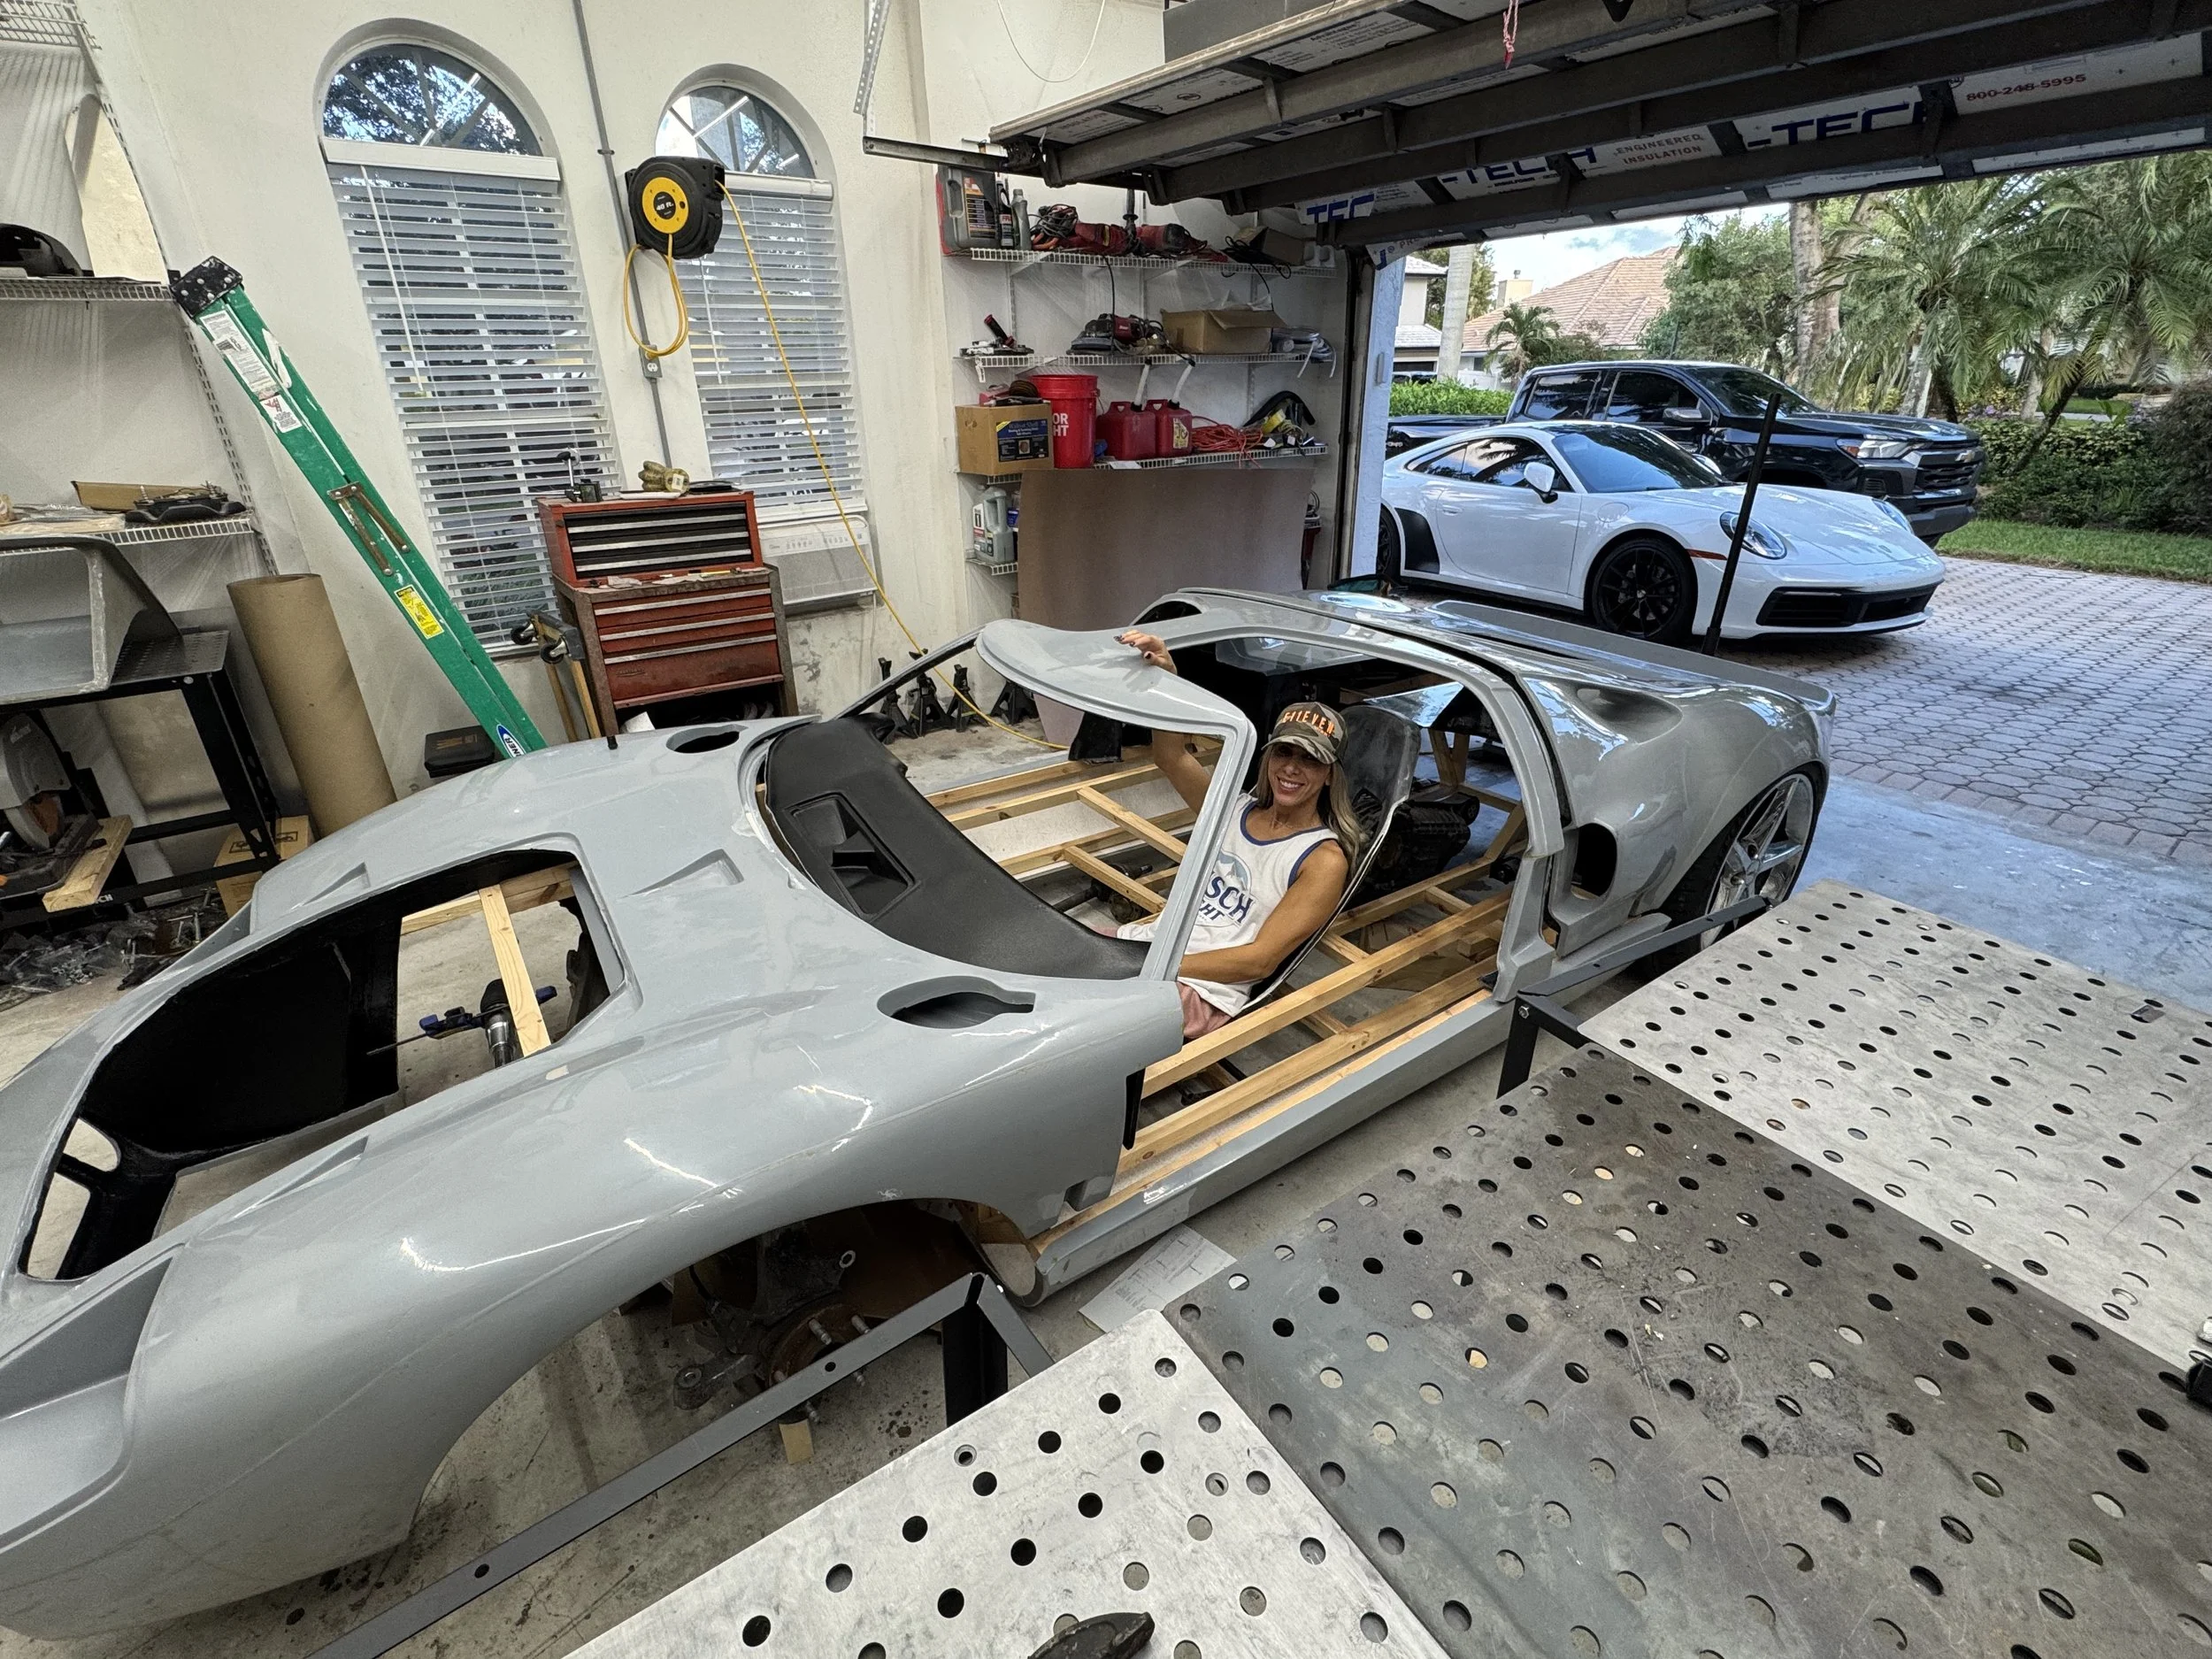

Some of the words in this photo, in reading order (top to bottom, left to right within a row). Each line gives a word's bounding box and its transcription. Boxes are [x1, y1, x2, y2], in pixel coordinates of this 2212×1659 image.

[1966, 73, 2087, 102] 800-248-5995
[1616, 134, 1702, 155] ENGINEERED
[1624, 144, 1702, 165] INSULATION
[504, 737, 522, 757] NER
[1204, 874, 1254, 924] SCH
[1199, 900, 1225, 920] HT
